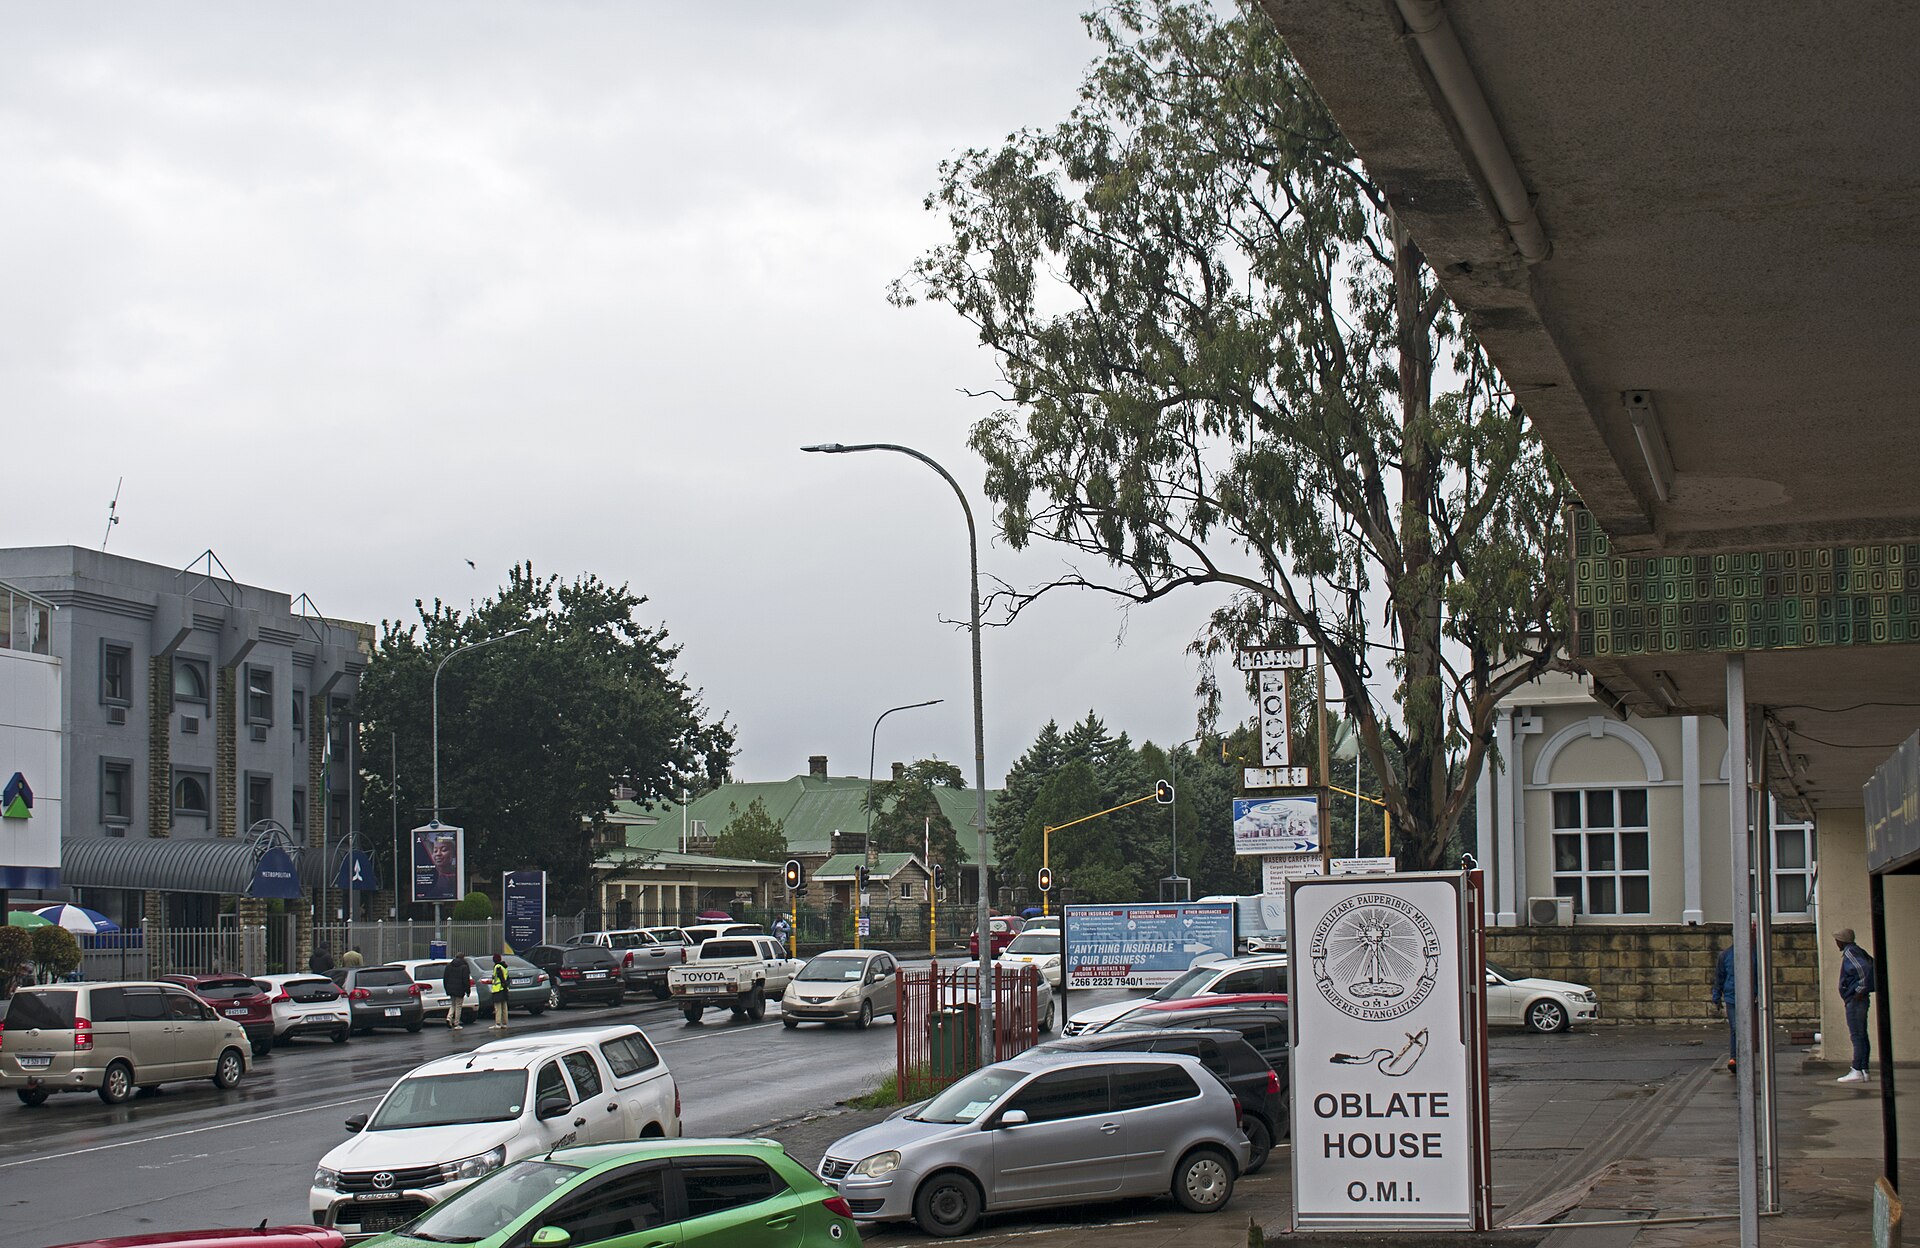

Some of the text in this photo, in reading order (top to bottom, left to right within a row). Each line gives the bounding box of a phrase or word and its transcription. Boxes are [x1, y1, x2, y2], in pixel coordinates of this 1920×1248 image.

[1288, 855, 1310, 863] CARPET
[1312, 895, 1439, 953] EVANGELIZARE PAUPERIBUS MISIT ME
[1122, 943, 1174, 953] INSURABLE
[1069, 956, 1078, 965] IS
[1080, 955, 1099, 965] OUR
[1102, 954, 1146, 964] BUSINESS
[682, 972, 726, 982] TOYOTA
[1070, 978, 1090, 986] +266
[1115, 978, 1143, 986] 7940/1
[1321, 981, 1432, 1019] PAUPERES EVANGELIZANTUR
[1314, 1092, 1450, 1118] OBLATE
[1324, 1132, 1442, 1158] HOUSE
[1347, 1181, 1420, 1202] O.M.I.
